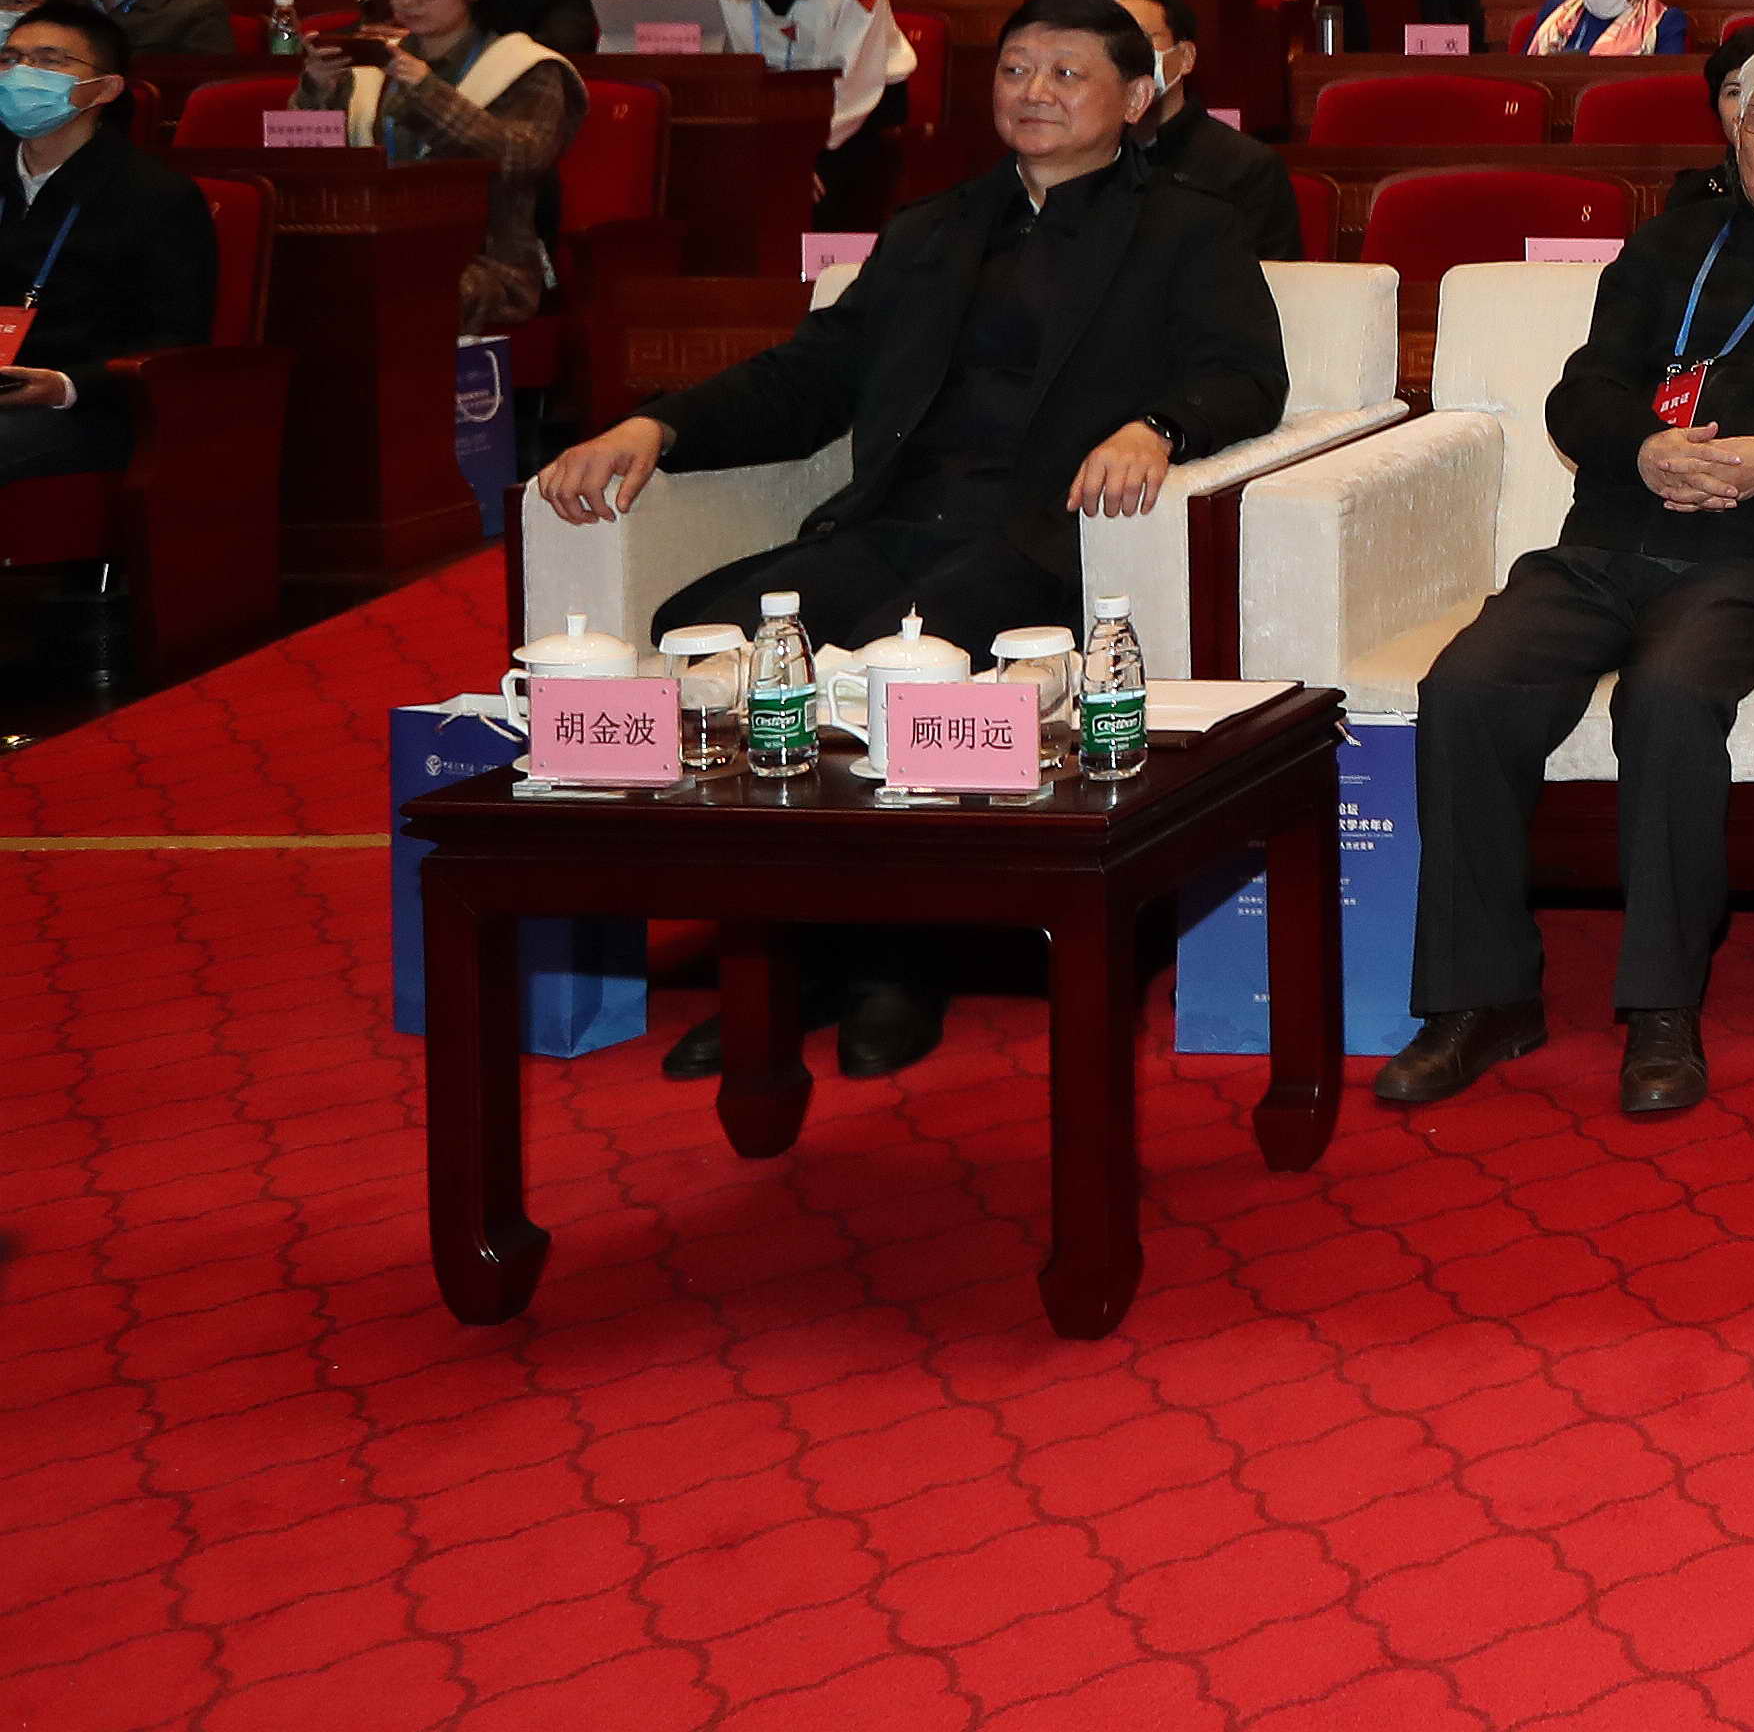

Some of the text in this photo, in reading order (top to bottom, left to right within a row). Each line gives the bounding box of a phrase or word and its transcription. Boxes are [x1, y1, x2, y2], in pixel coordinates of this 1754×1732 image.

[1504, 100, 1520, 117] 10
[1581, 204, 1592, 223] 8
[554, 710, 658, 747] 胡金波
[910, 715, 1014, 750] 顾明远
